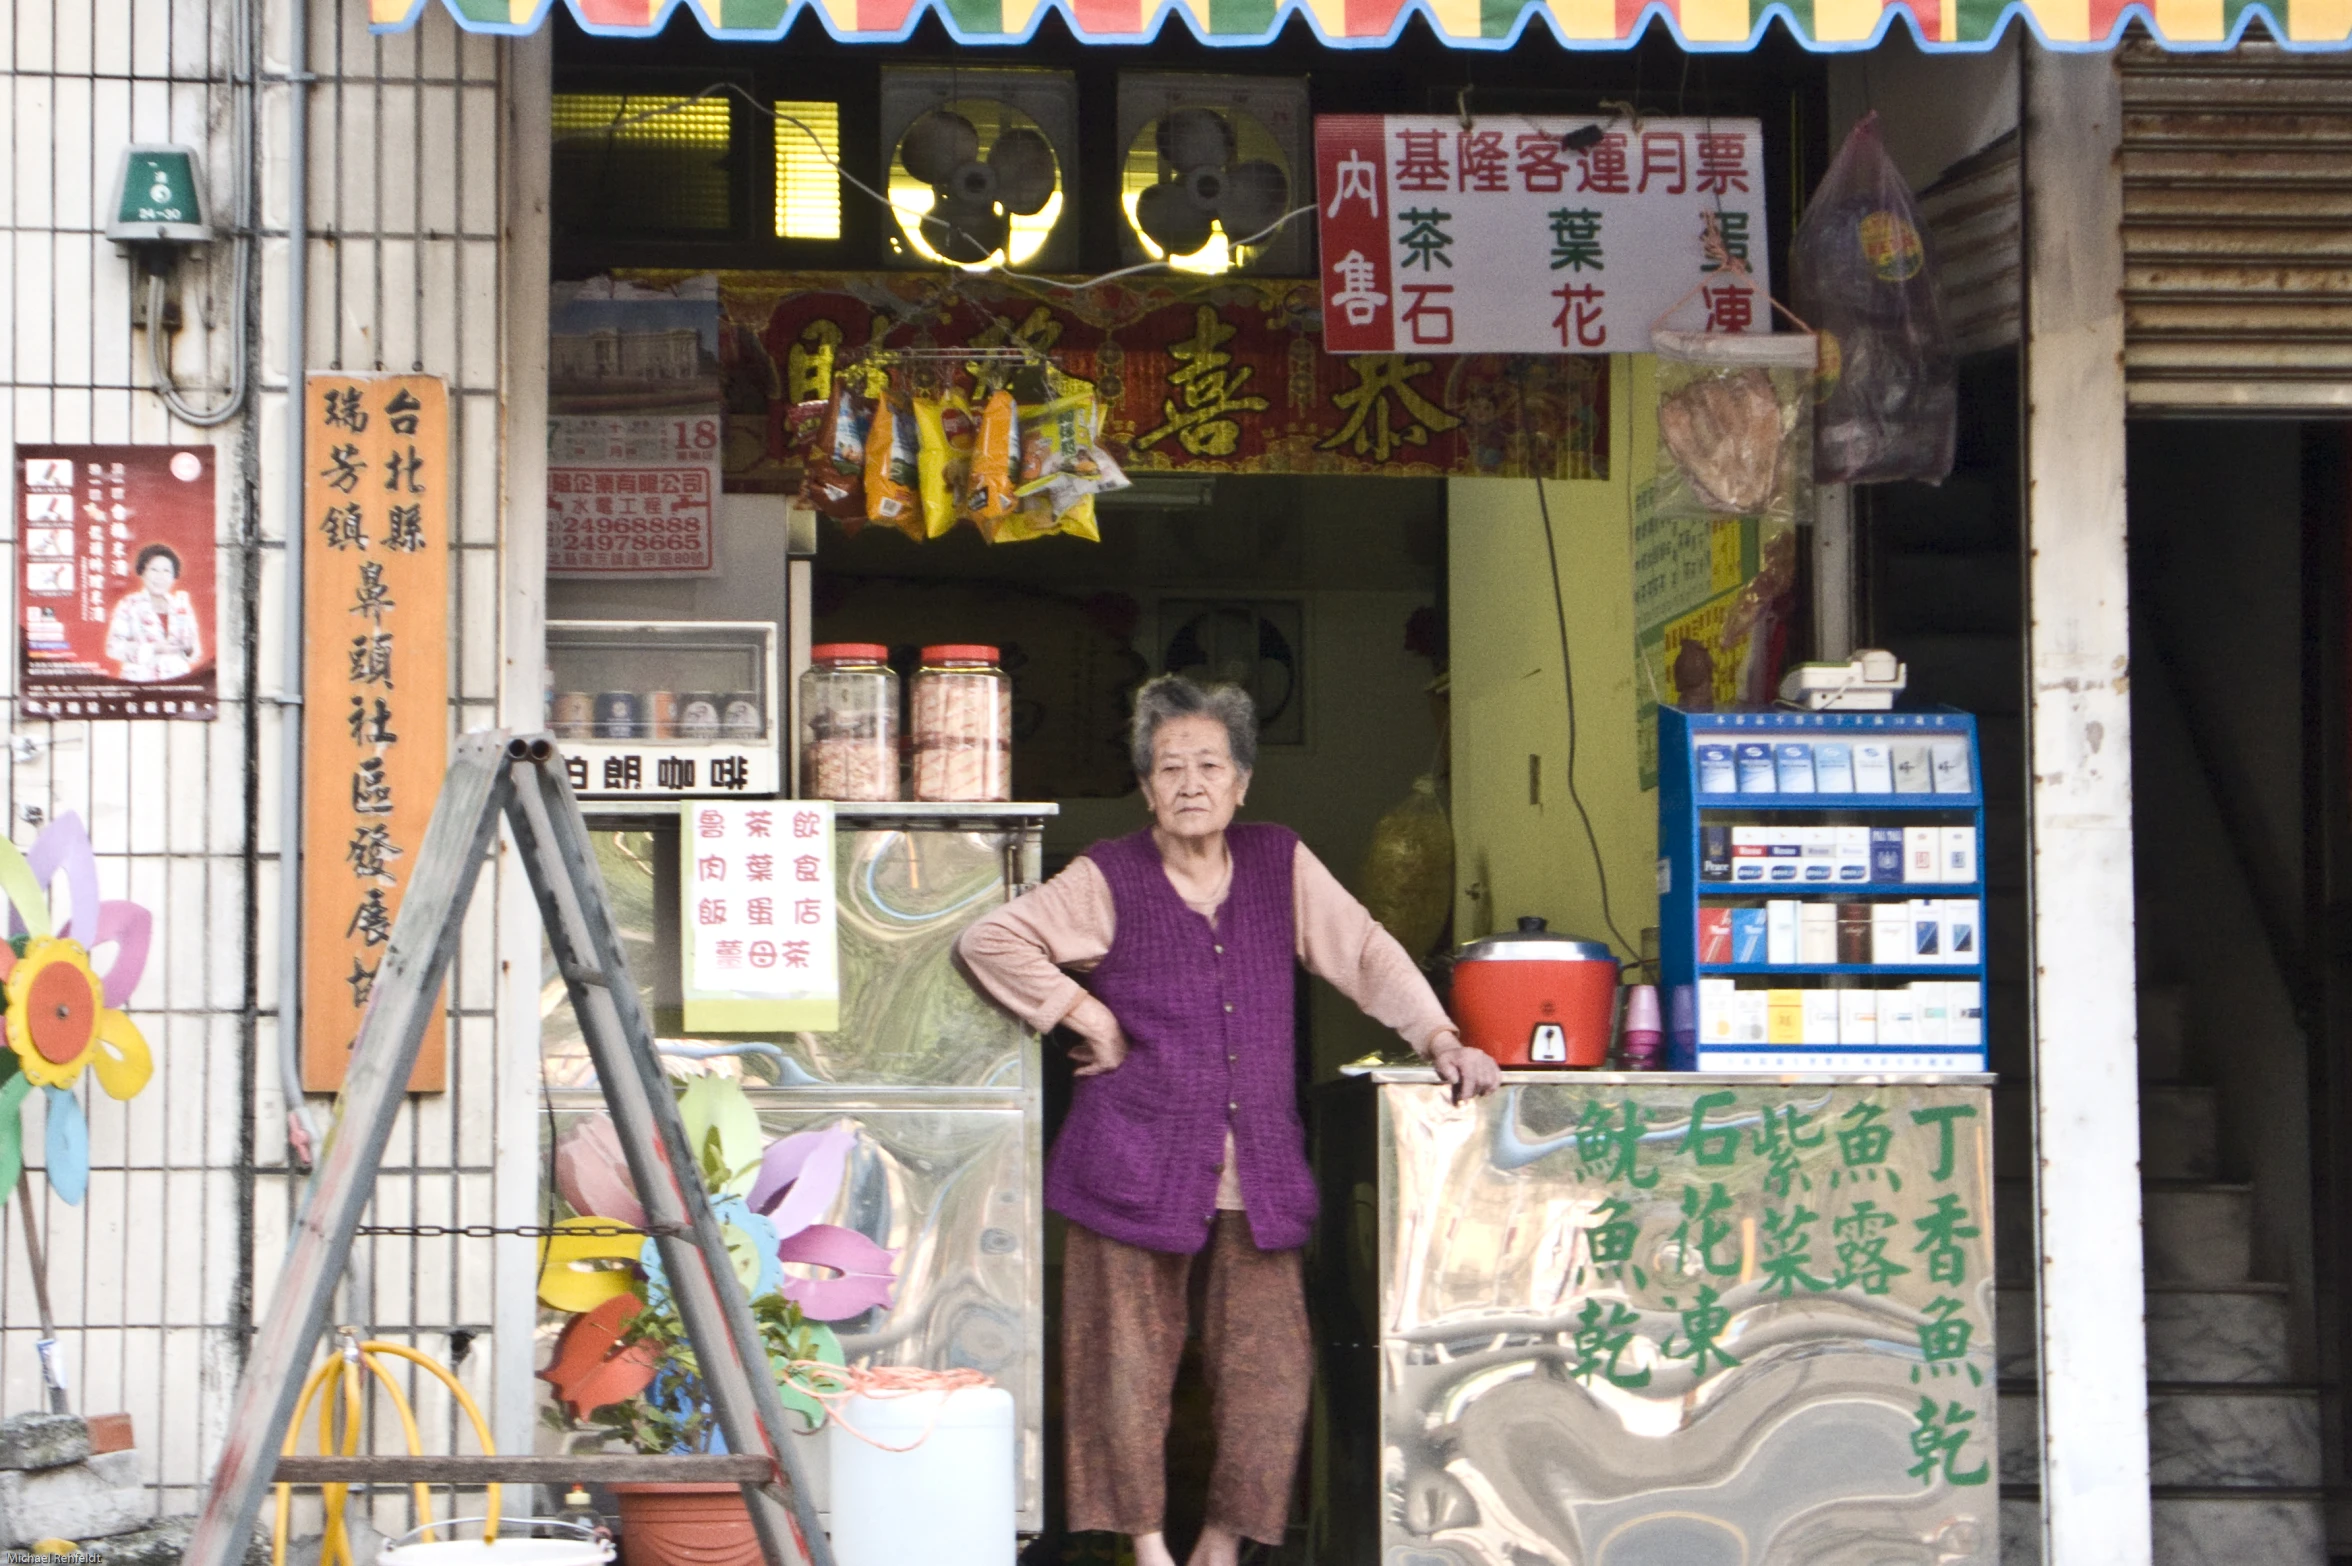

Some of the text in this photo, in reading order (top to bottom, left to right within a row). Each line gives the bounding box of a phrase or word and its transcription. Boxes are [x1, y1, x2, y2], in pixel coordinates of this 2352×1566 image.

[1395, 127, 1749, 196] 基隆客運月票
[320, 385, 370, 552] 瑞芳鎮
[380, 387, 426, 553] 台北縣
[674, 420, 718, 449] 18
[346, 561, 403, 1050] 鼻頭社區發展
[698, 809, 728, 926] 魯肉飯
[745, 810, 774, 926] 茶葉蛋
[792, 810, 821, 926] 飲食店
[1570, 1099, 1660, 1389] 魷魚乾
[1752, 1103, 1836, 1299] 紫菜
[1830, 1101, 1911, 1296] 魚露
[1907, 1103, 1990, 1487] 丁香魚乾
